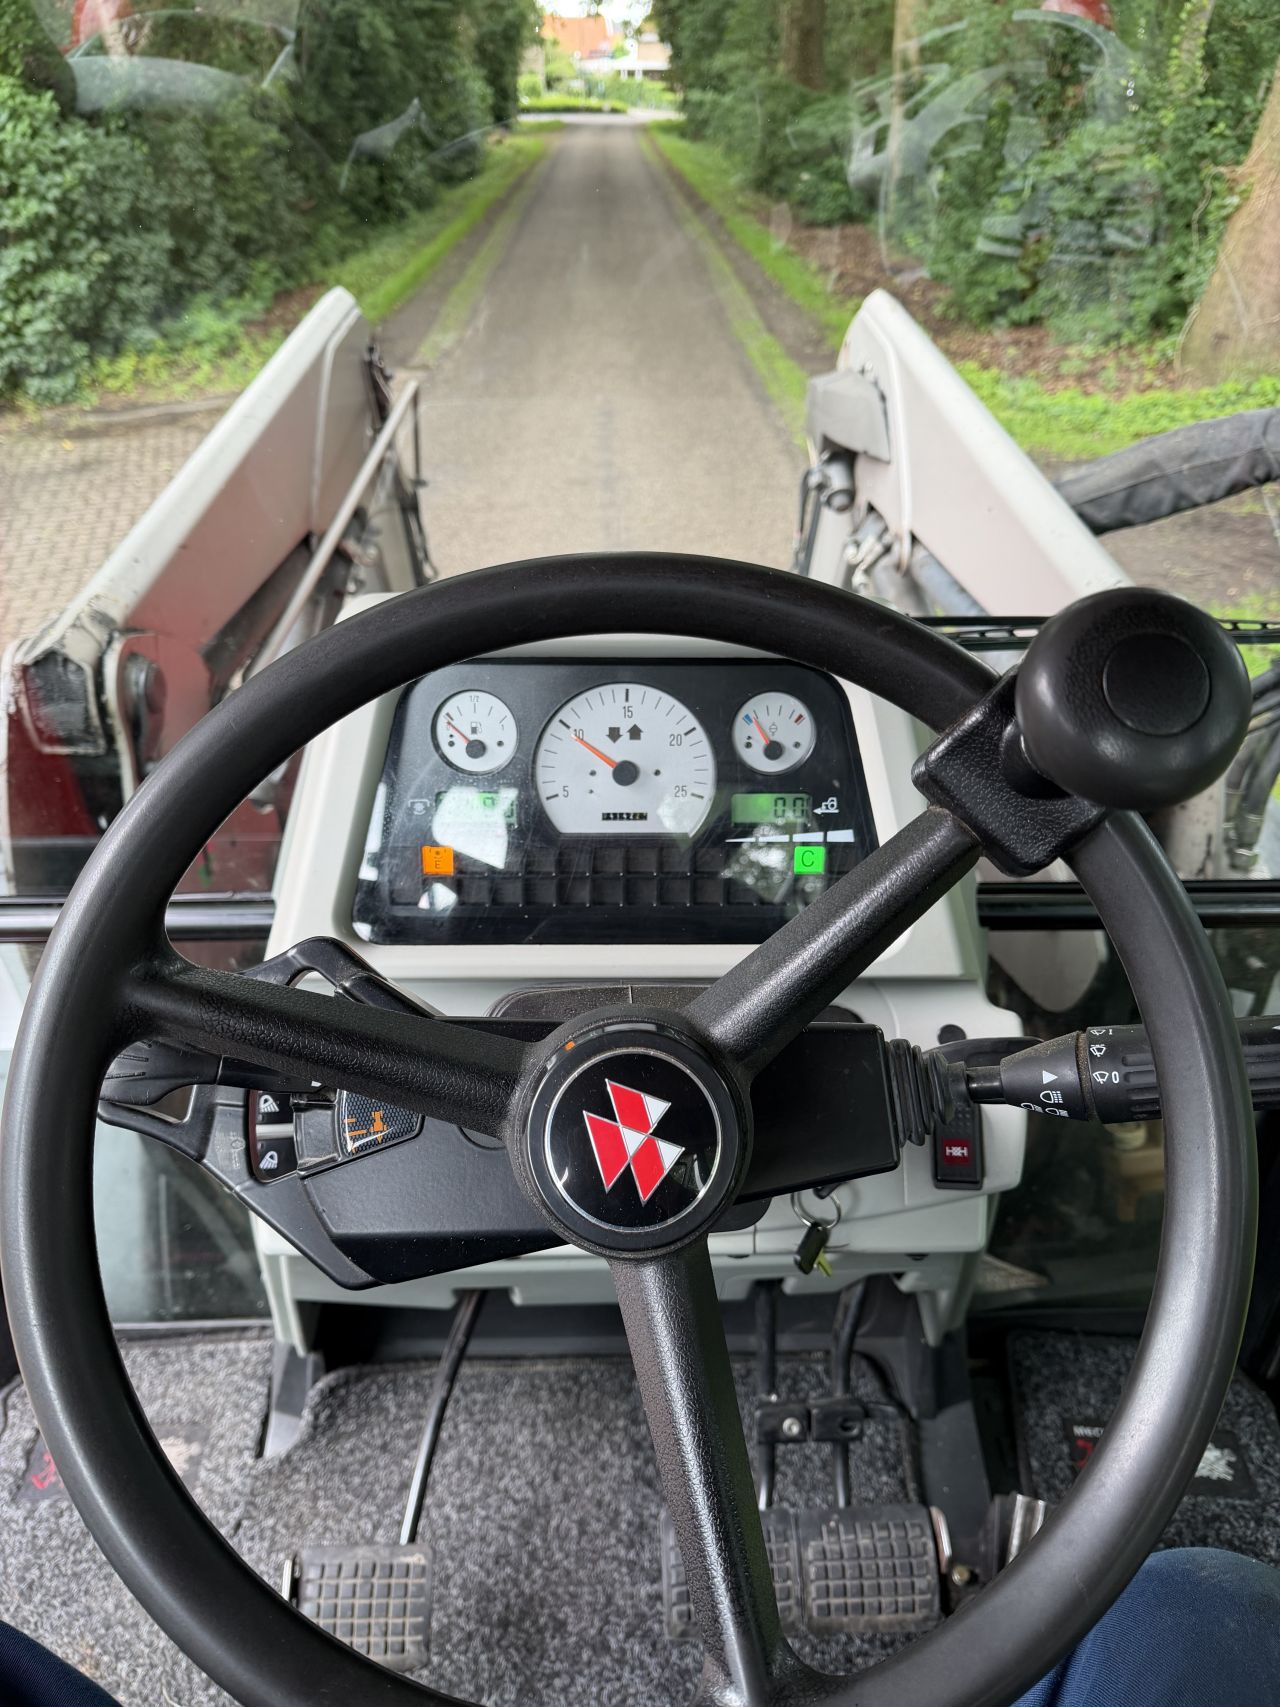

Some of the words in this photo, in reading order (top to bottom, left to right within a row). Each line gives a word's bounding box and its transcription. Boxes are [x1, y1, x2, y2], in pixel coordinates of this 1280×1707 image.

[622, 705, 634, 719] 15
[573, 728, 585, 741] 10
[669, 734, 683, 747] 20
[562, 785, 570, 798] 5
[674, 785, 688, 798] 25
[801, 850, 815, 868] C
